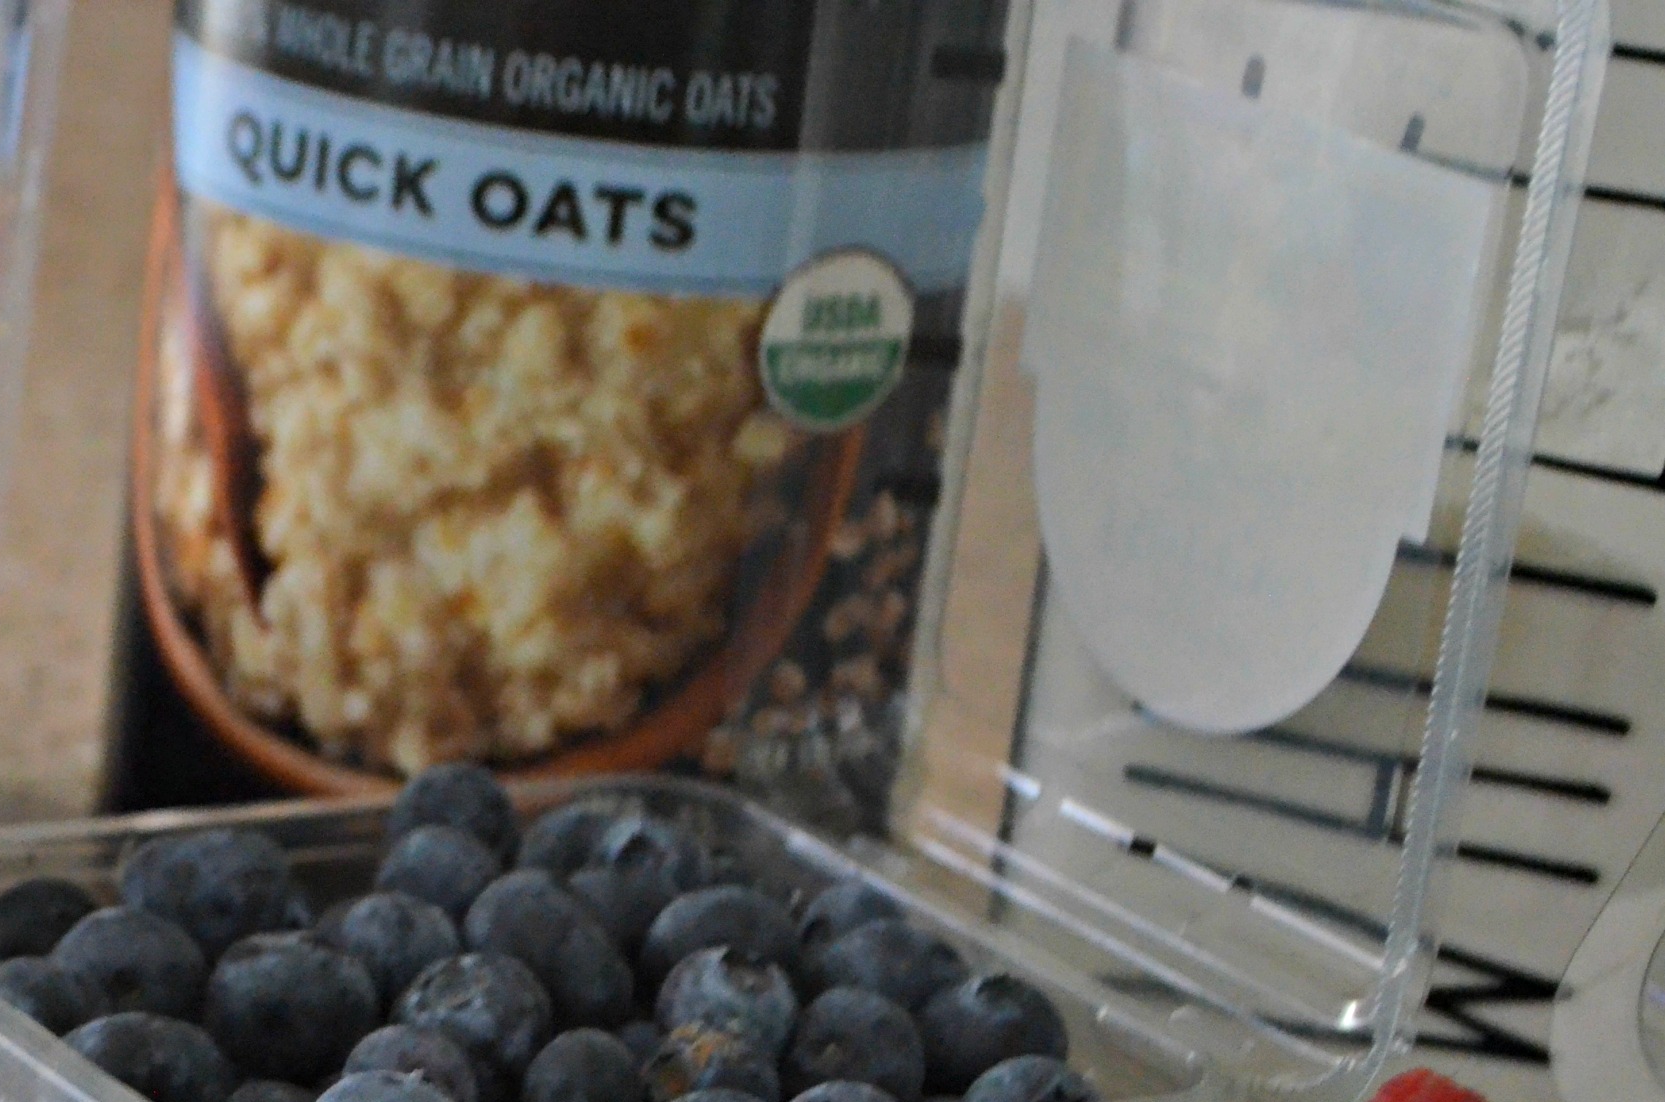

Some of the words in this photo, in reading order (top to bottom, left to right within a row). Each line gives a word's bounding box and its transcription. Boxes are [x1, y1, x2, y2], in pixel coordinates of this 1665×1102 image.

[268, 6, 380, 80] WHOLE
[384, 25, 495, 102] GRAIN
[501, 48, 678, 124] ORGANIC
[683, 69, 780, 131] OATS
[227, 108, 439, 218] QUICK
[470, 167, 698, 252] OATS
